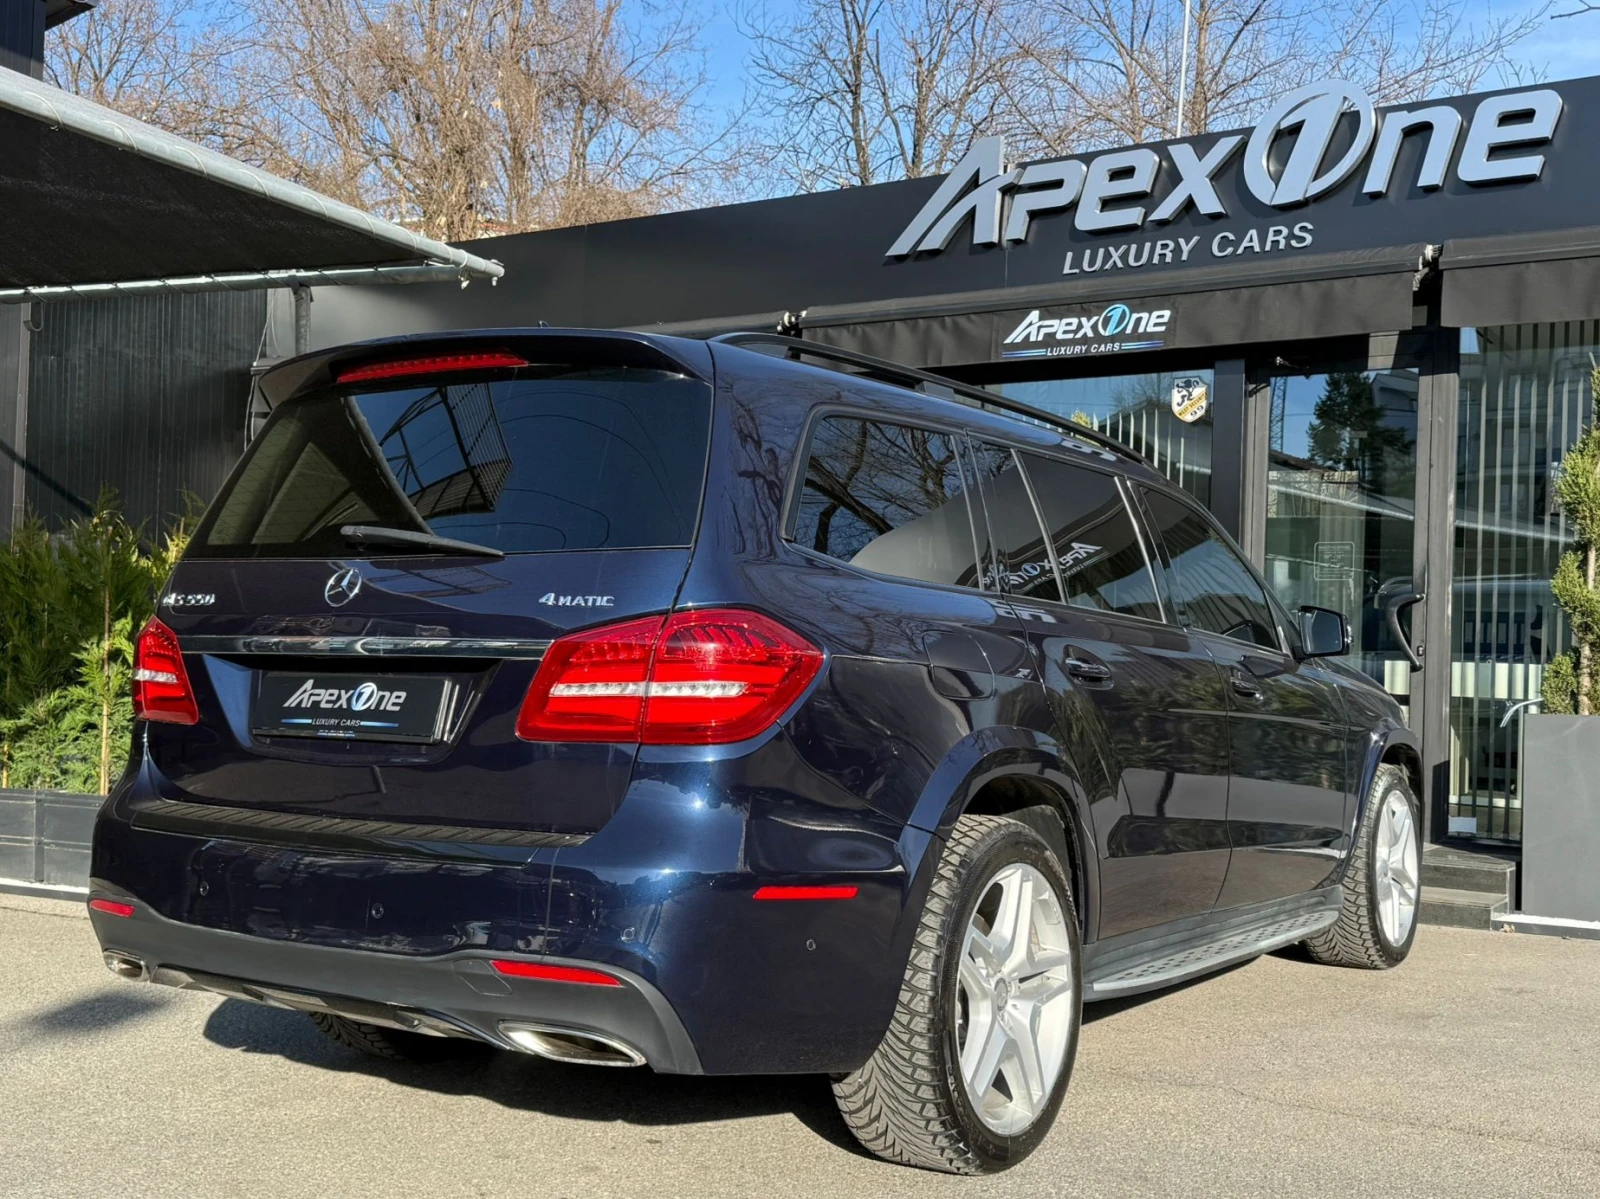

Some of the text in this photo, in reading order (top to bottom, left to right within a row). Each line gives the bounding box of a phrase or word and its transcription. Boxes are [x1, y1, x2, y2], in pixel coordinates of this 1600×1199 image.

[1063, 221, 1314, 276] LUXURY CARS
[1046, 342, 1121, 357] LUXURY CARS
[311, 717, 362, 728] LUXURY CARS
